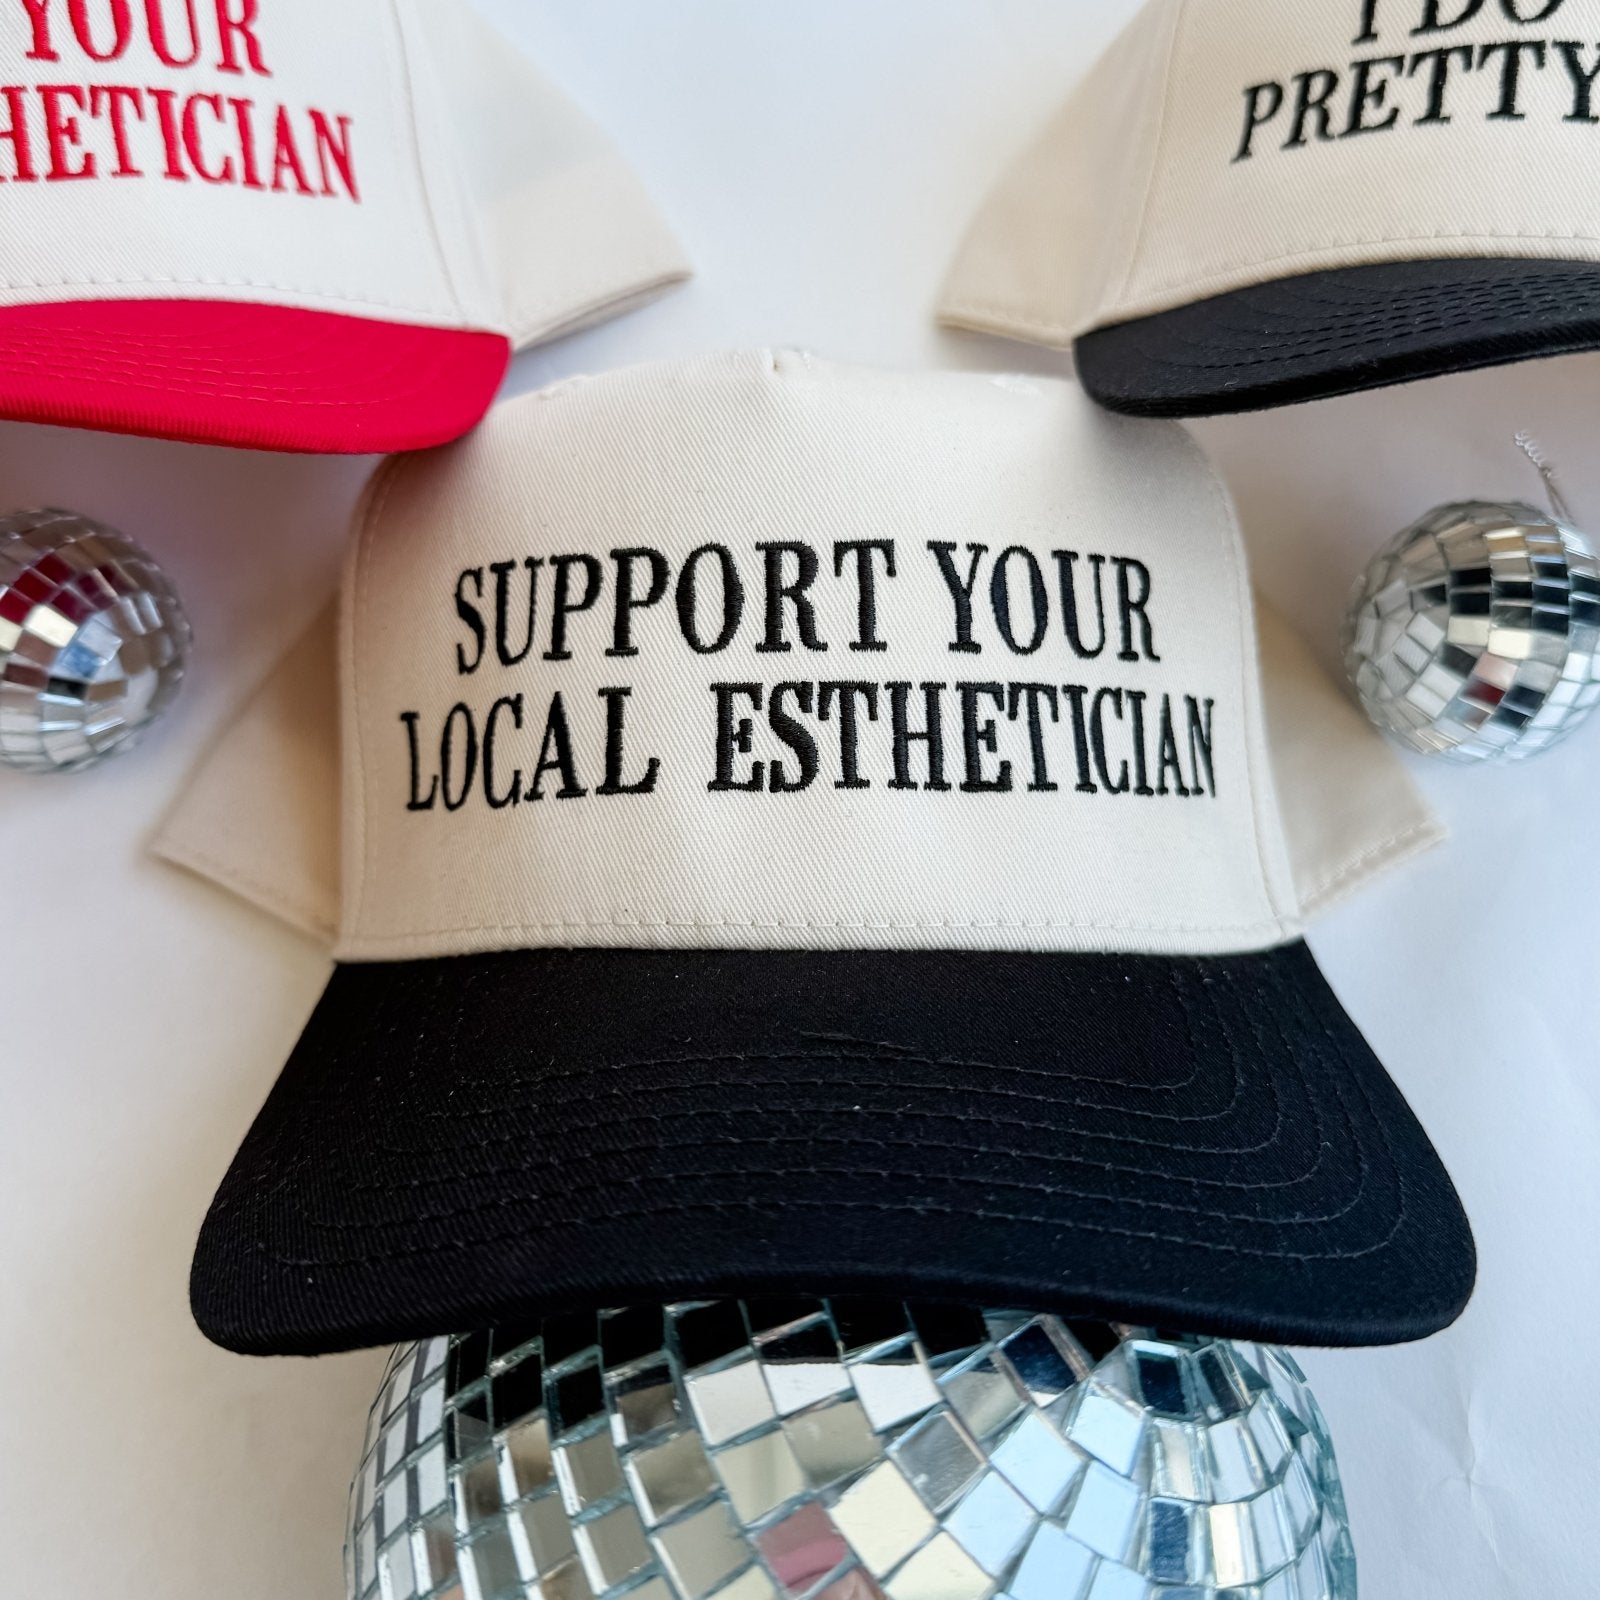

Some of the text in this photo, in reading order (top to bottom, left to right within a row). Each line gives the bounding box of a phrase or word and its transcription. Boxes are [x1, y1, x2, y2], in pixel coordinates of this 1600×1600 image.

[21, 0, 271, 76] YOUR
[1230, 40, 1600, 163] PRETTY
[453, 538, 1162, 676] SUPPORT YOUR
[398, 679, 1217, 813] LOCAL ESTHETICIAN
